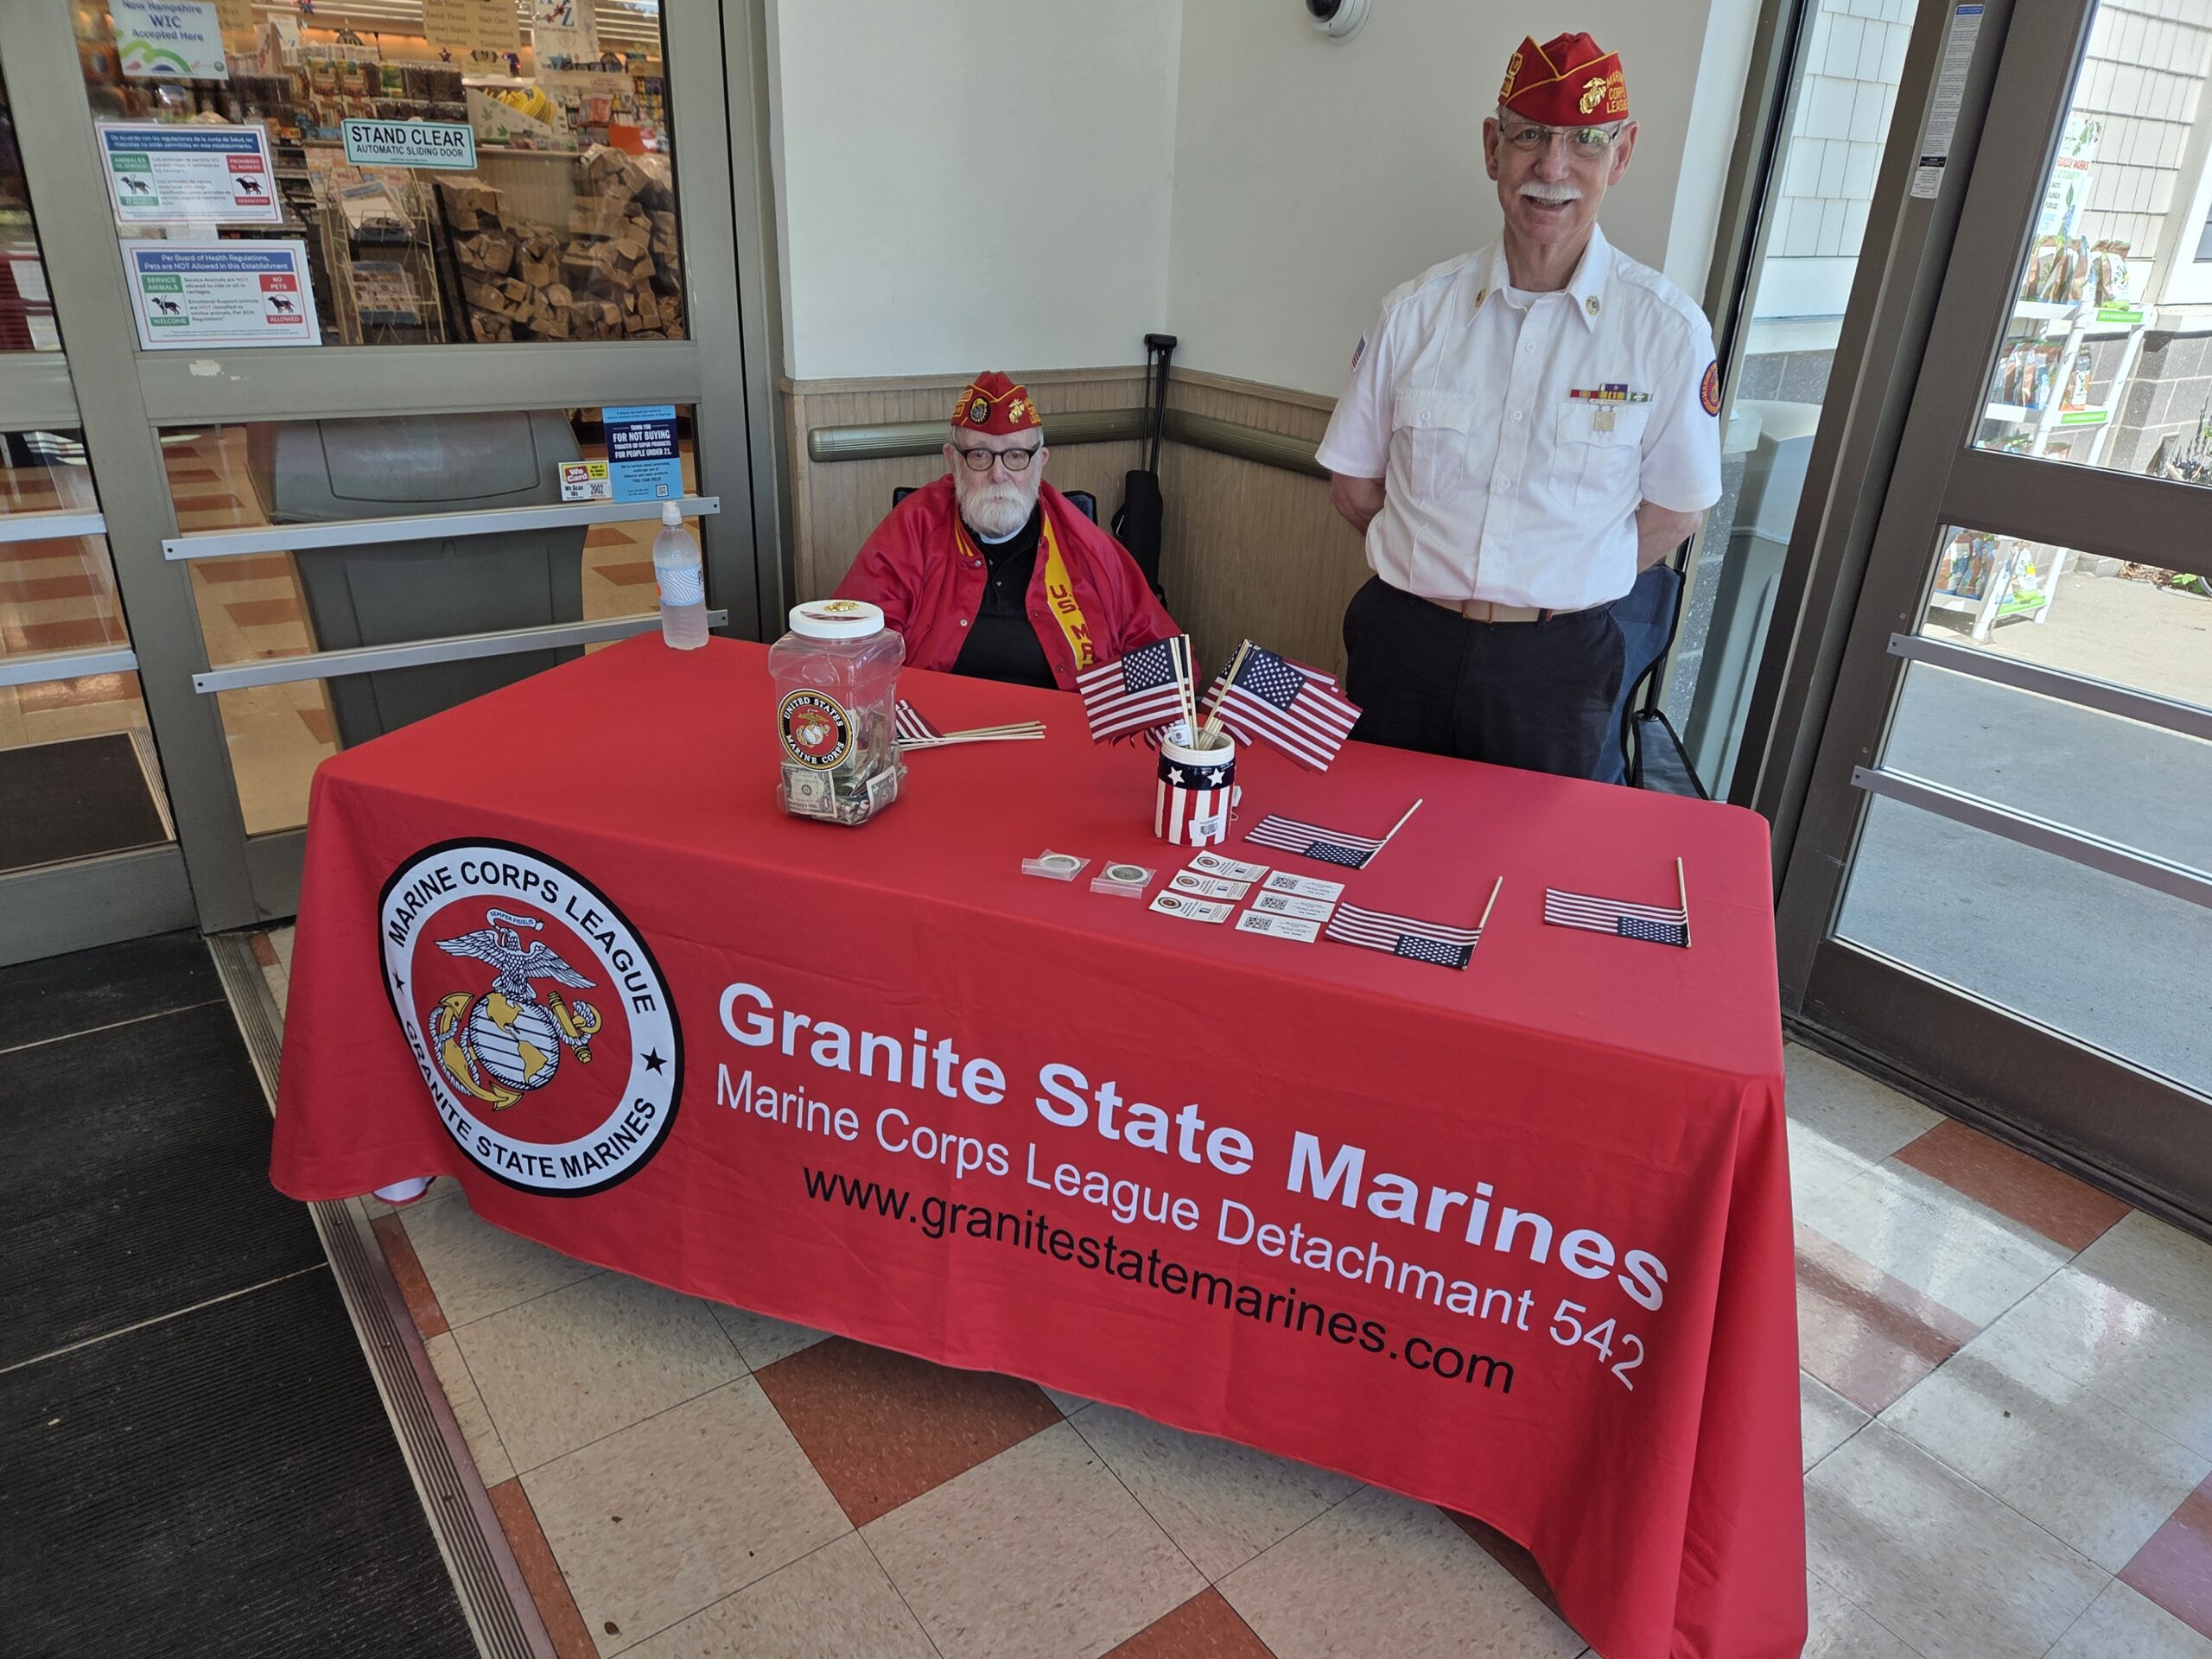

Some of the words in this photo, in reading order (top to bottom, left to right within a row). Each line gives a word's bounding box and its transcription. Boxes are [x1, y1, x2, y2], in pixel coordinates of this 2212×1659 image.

[123, 1, 145, 10] New
[148, 2, 202, 15] Hampshire
[149, 14, 181, 28] WIC
[132, 29, 177, 40] Accepted
[181, 30, 204, 41] Here
[1606, 70, 1624, 88] MARIN
[352, 126, 406, 143] STAND
[411, 130, 465, 147] CLEAR
[356, 144, 404, 155] AUTOMATIC
[406, 147, 438, 156] SLIDING
[440, 149, 463, 157] DOOR
[228, 254, 269, 263] Regulations,
[613, 432, 627, 442] FOR
[629, 431, 642, 442] NOT
[644, 429, 671, 441] BUYING
[615, 450, 626, 459] FOR
[626, 449, 645, 458] PEOPLE
[645, 448, 664, 456] UNDER
[567, 473, 588, 482] Card
[590, 484, 604, 494] 2002
[783, 696, 810, 720] UNITED
[814, 698, 843, 728] STATES
[785, 734, 817, 765] MARINE
[822, 742, 845, 764] CORPS
[490, 911, 512, 922] SEMPER
[388, 867, 457, 948] MARINE
[460, 861, 559, 903] CORPS
[565, 895, 657, 1014] LEAGUE
[405, 1020, 473, 1141] GRANITE
[476, 1135, 556, 1179] STATE
[561, 1097, 656, 1179] MARINES
[719, 982, 1007, 1105] Granite
[1035, 1063, 1255, 1175] State
[1287, 1131, 1669, 1312] Marines
[716, 1064, 859, 1141] Marine
[876, 1109, 1009, 1179] Corps
[1027, 1142, 1200, 1231] League
[1217, 1198, 1535, 1331] Detachmant
[1548, 1300, 1645, 1391] 542
[804, 1166, 1515, 1394] www.granitestatemarines.com
